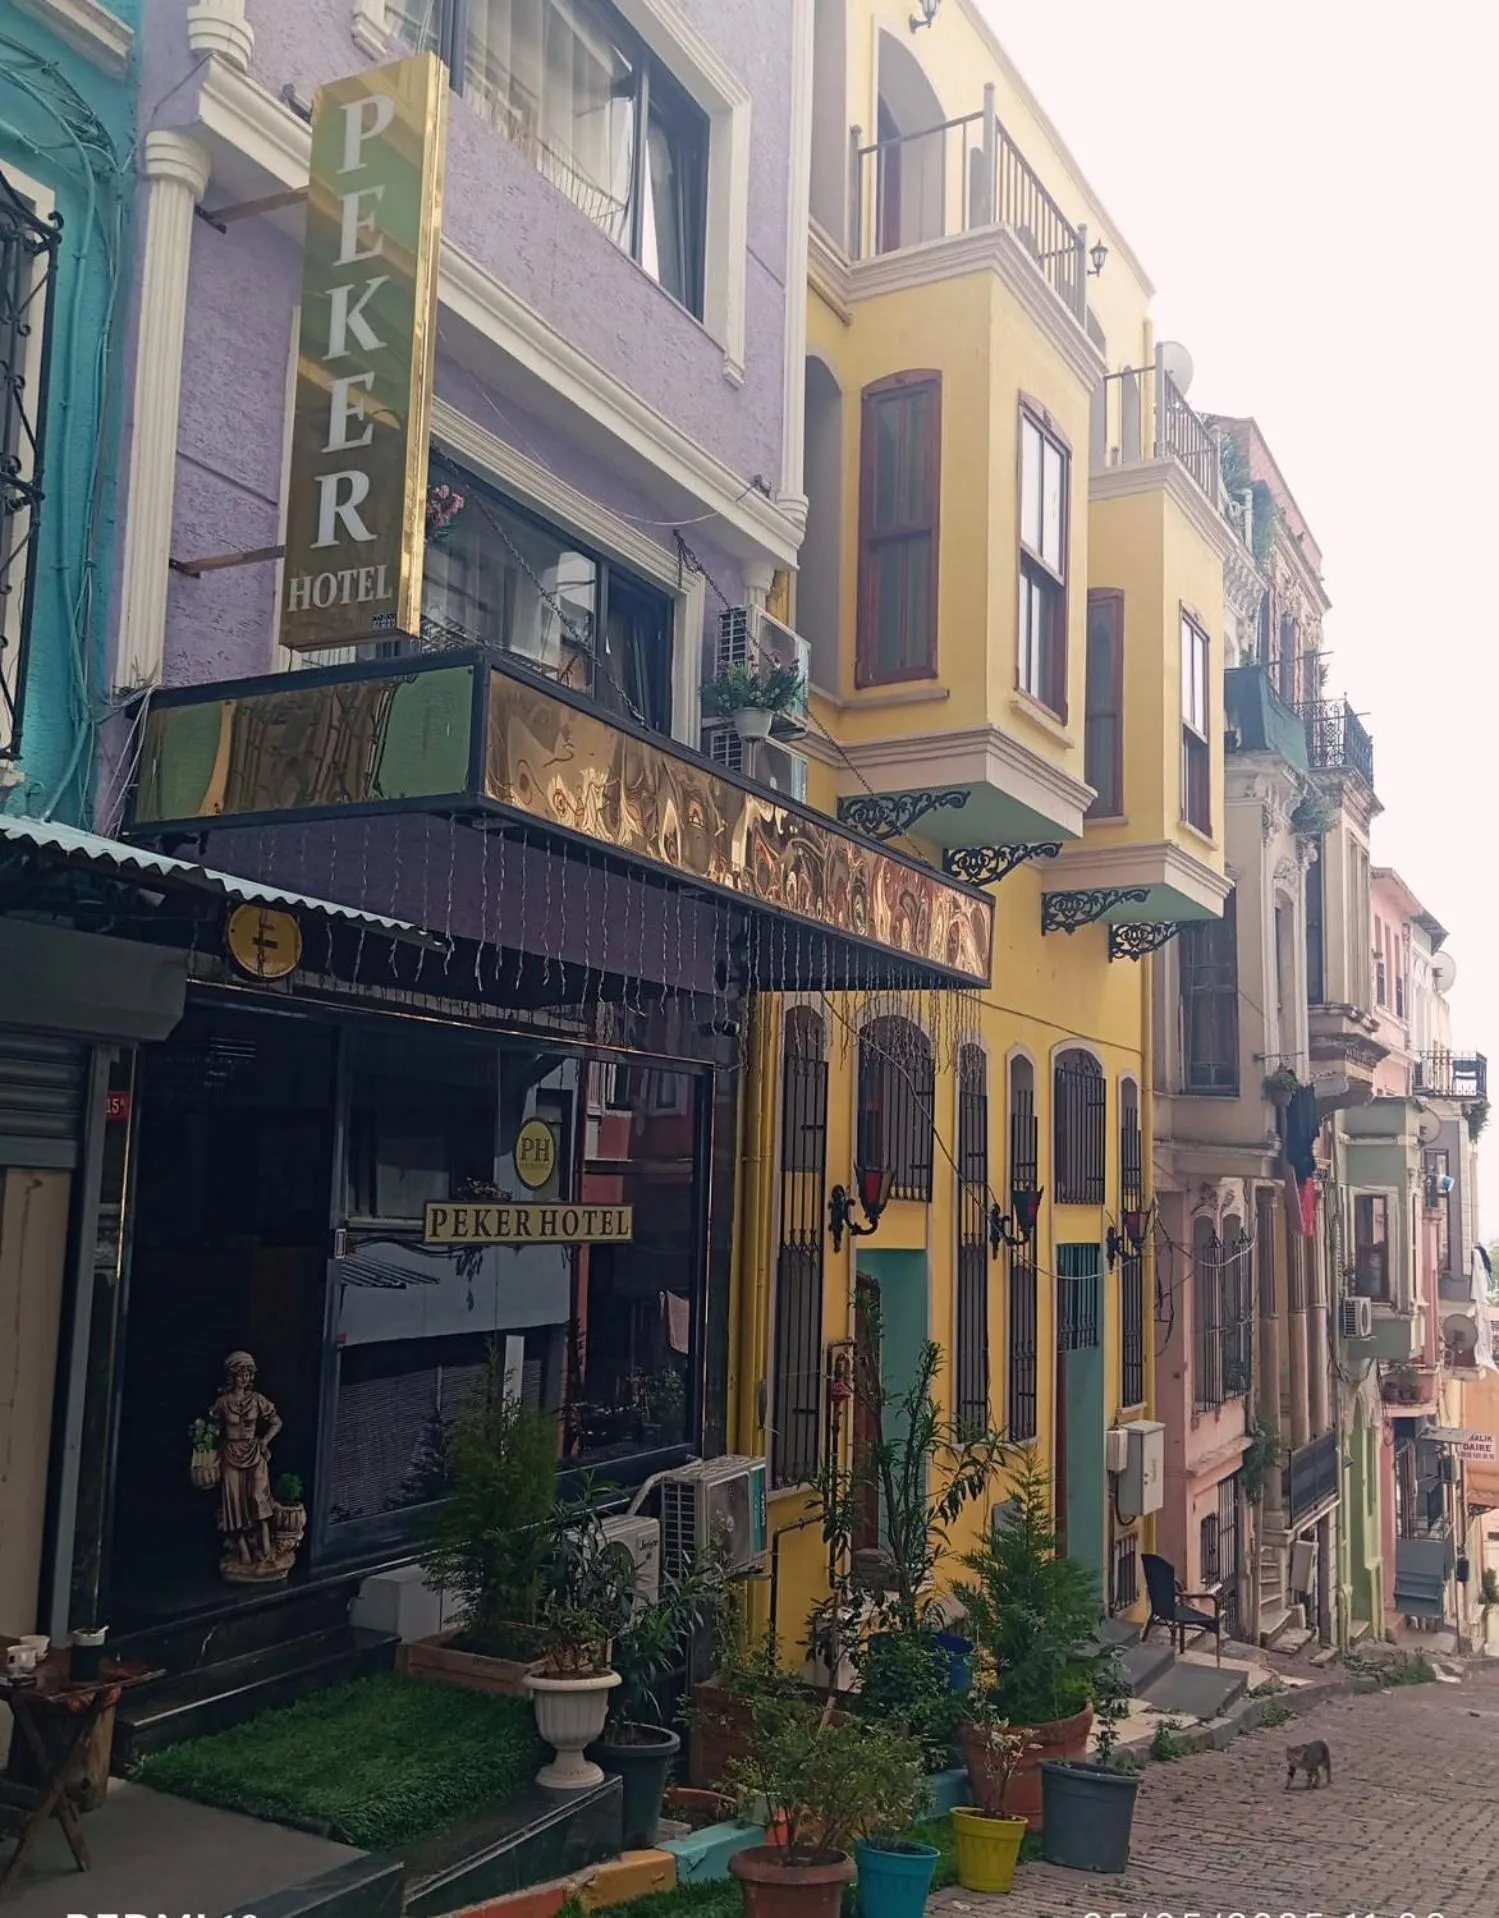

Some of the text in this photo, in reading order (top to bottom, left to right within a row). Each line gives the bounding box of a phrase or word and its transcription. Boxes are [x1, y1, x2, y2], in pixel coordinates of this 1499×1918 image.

[311, 95, 395, 551] PEKER
[286, 565, 393, 612] HOTEL
[521, 1136, 550, 1161] PH
[429, 1208, 629, 1237] PEKER HOTEL
